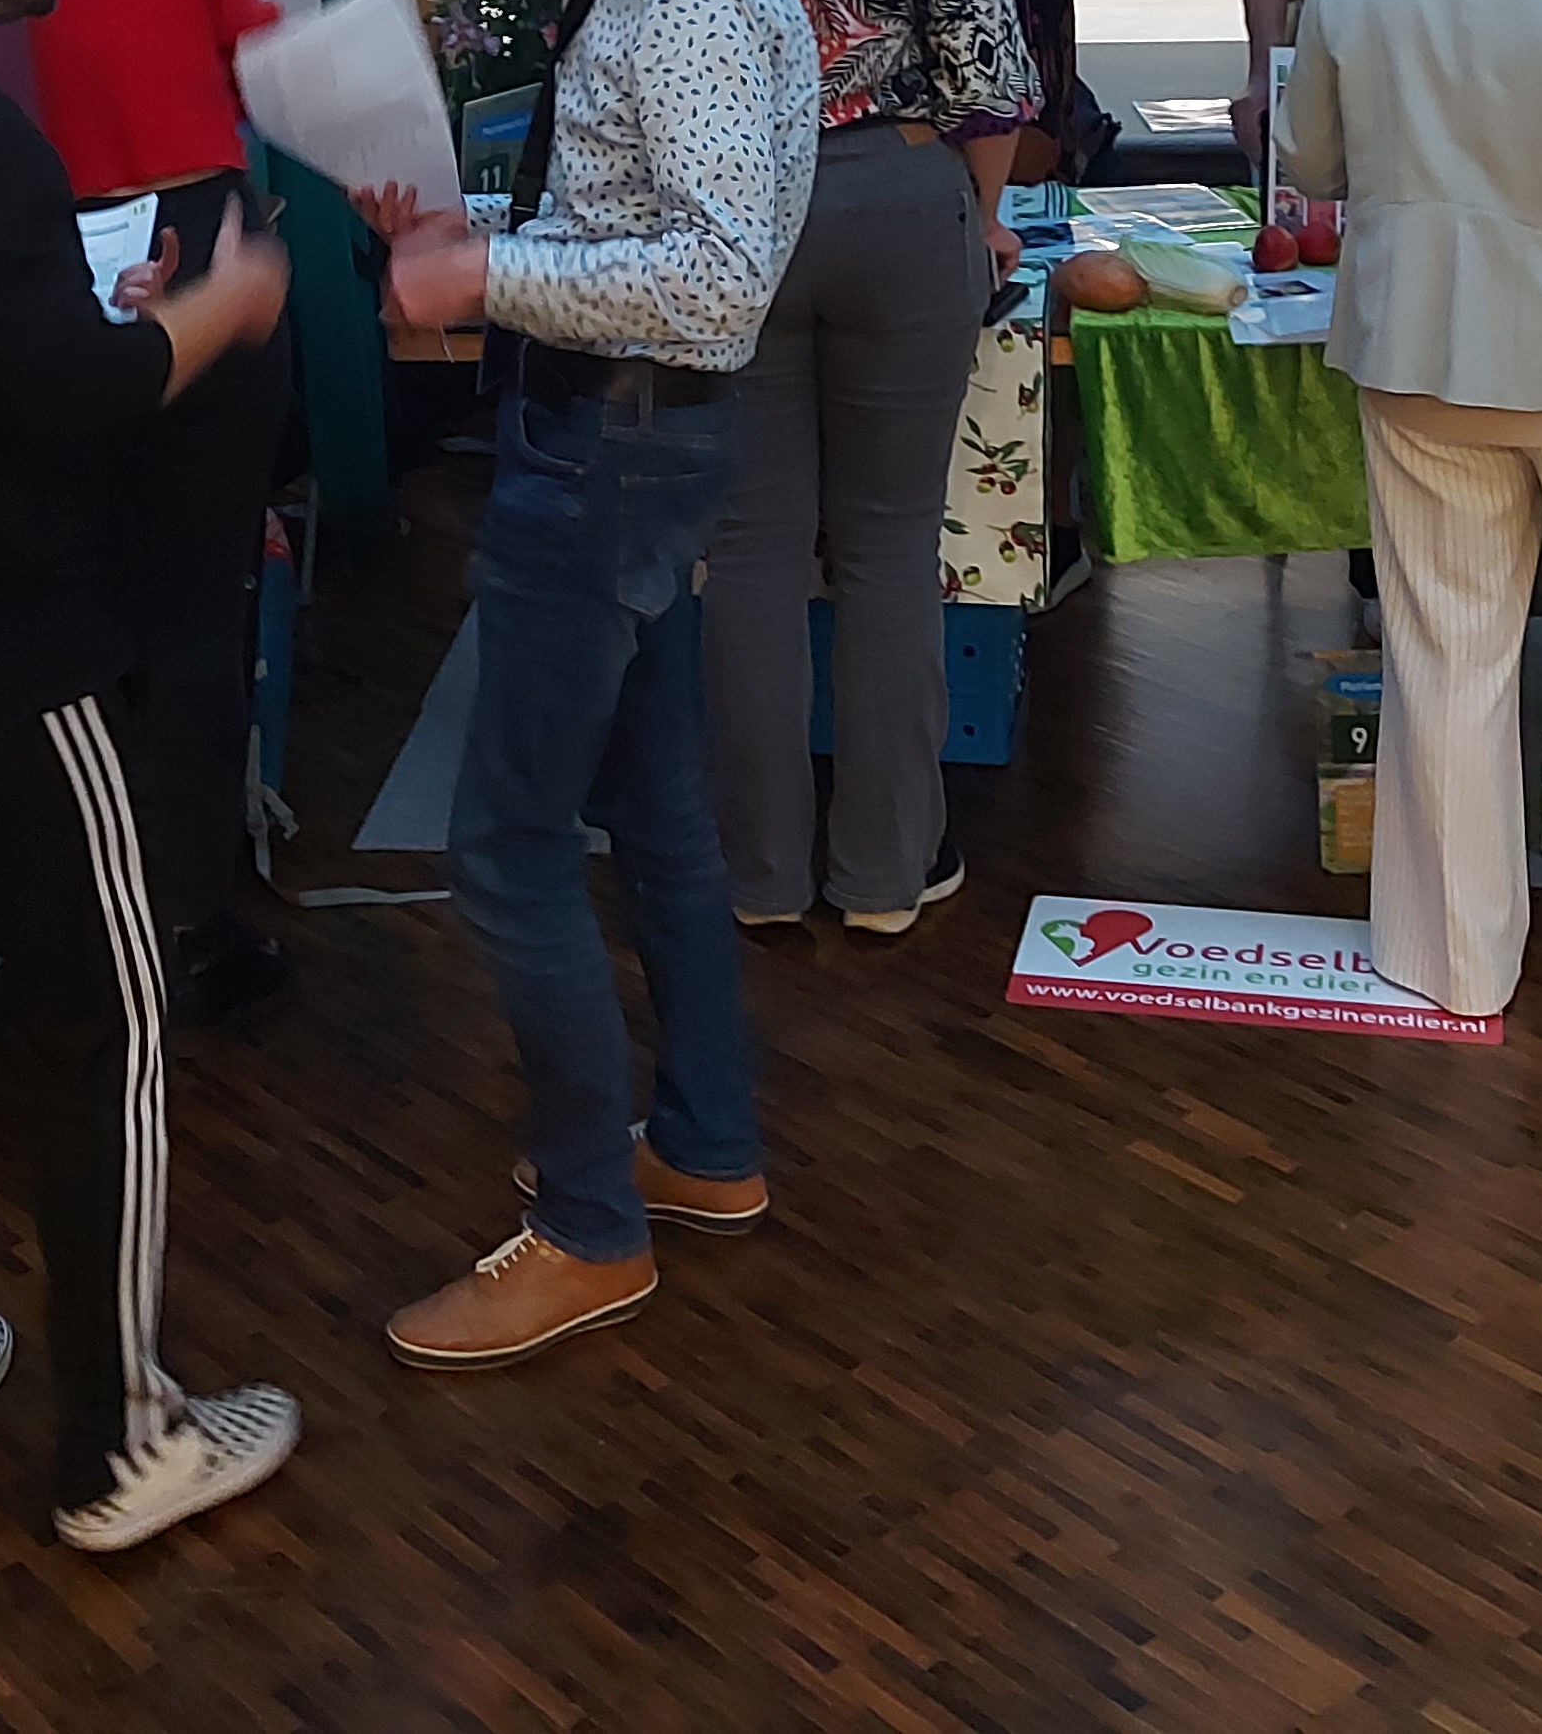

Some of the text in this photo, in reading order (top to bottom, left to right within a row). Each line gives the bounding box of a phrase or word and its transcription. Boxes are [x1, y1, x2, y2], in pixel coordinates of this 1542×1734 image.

[480, 165, 502, 192] 11
[1350, 726, 1369, 754] 9
[1129, 937, 1373, 974] Voedselb
[1132, 961, 1381, 994] gezin en dier
[1026, 981, 1487, 1034] www.voedselbankgezinendier.nl
